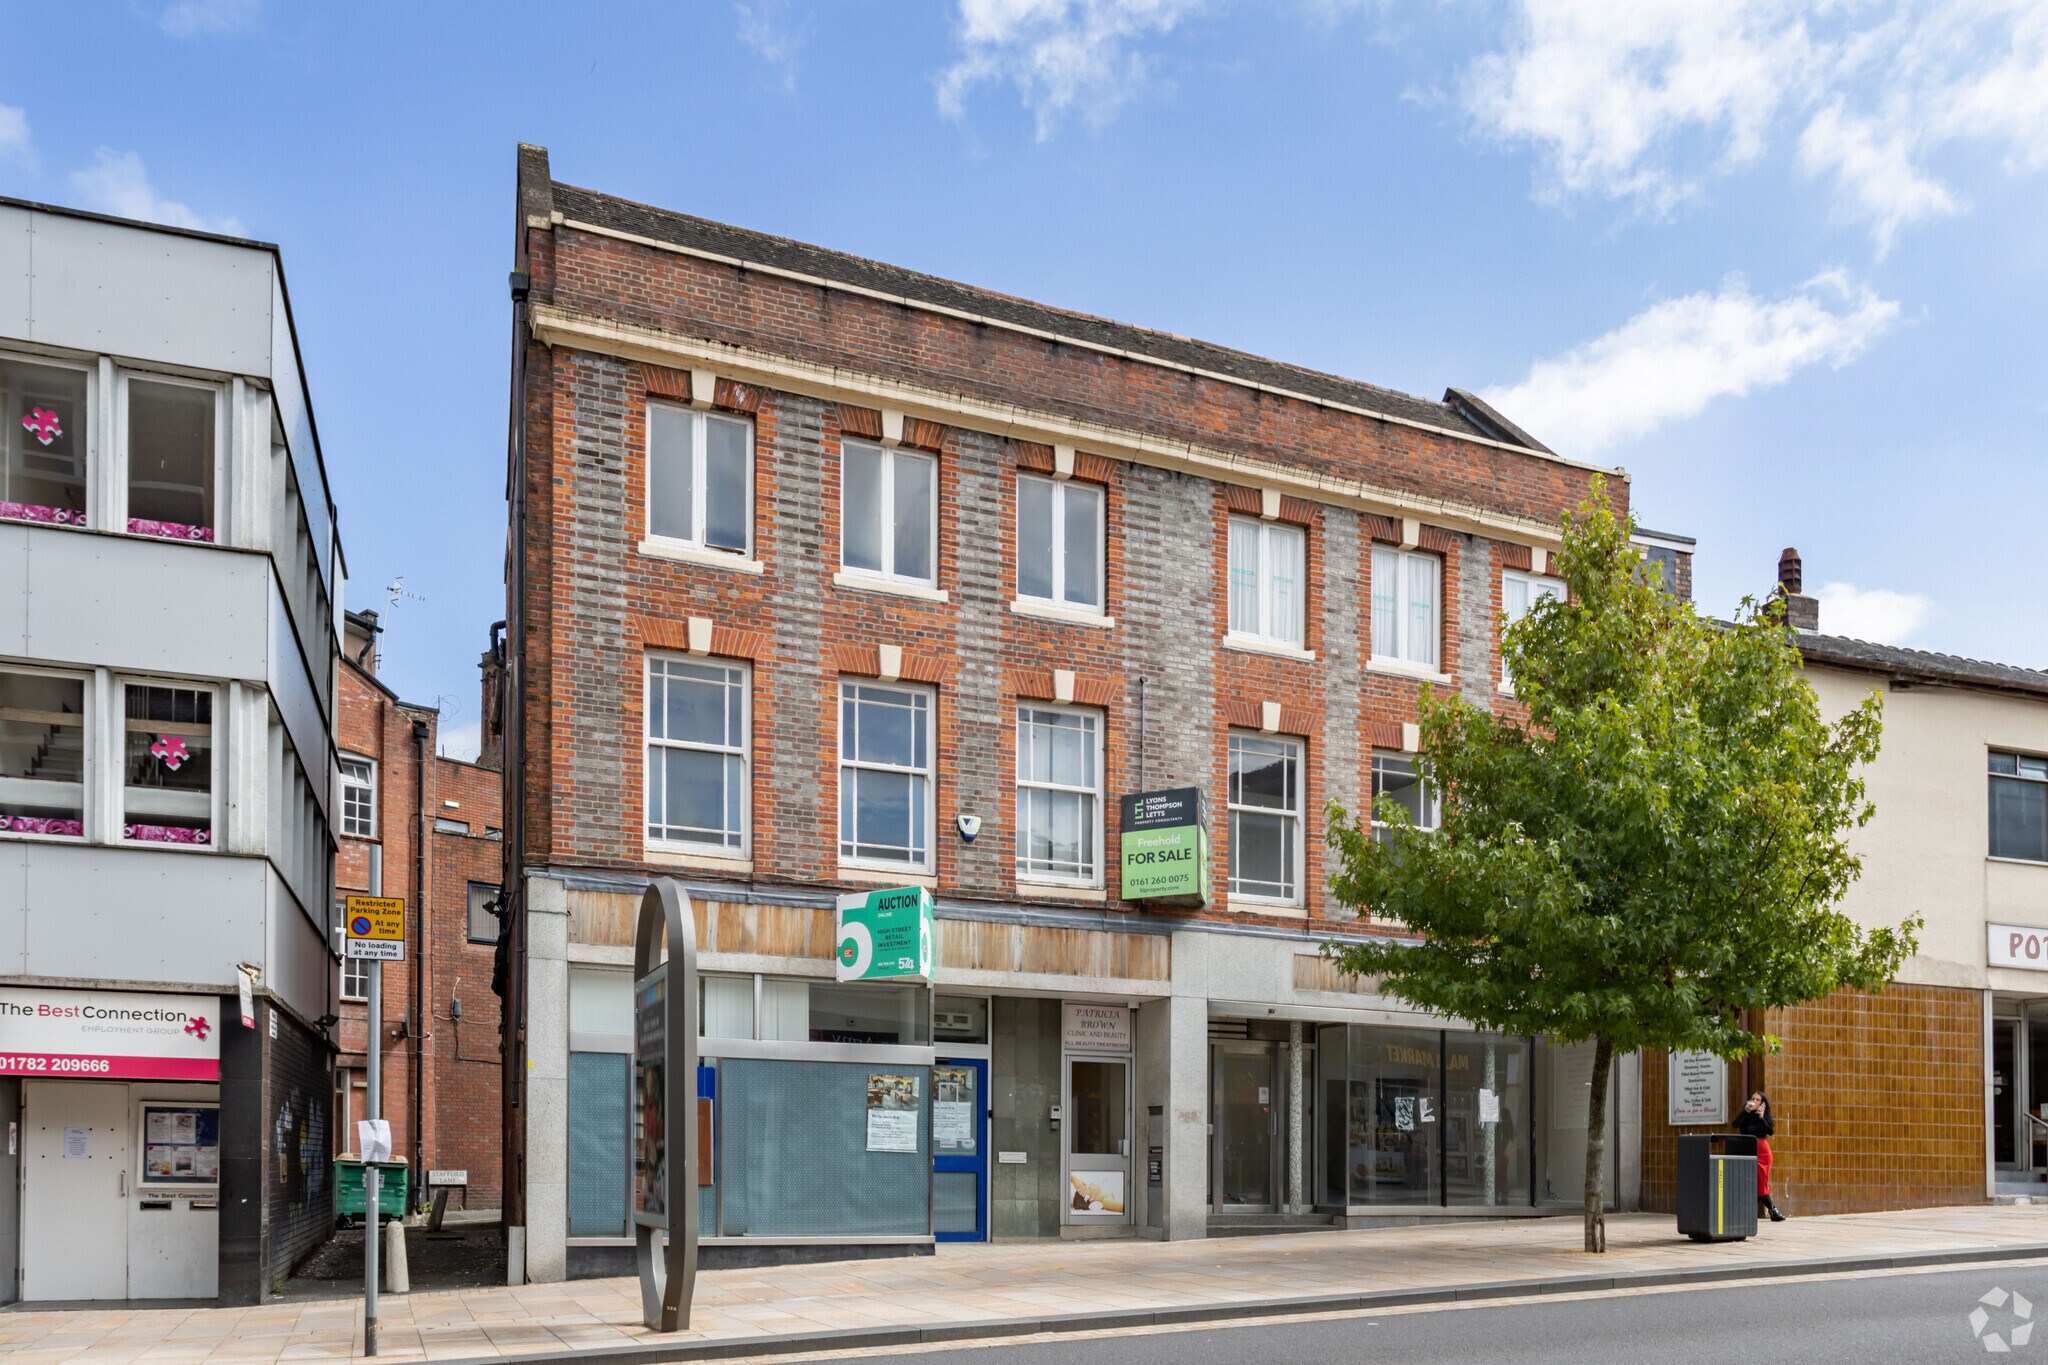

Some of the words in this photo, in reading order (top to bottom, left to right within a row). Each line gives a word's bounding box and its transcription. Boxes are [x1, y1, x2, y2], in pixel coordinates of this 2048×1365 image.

[1146, 796, 1166, 804] LYONS
[1146, 802, 1182, 810] THOMPSON
[1137, 834, 1180, 848] Freehold
[1128, 852, 1156, 866] FOR
[1158, 848, 1192, 862] SALE
[1130, 878, 1148, 886] 0161
[1152, 876, 1166, 884] 260
[1168, 874, 1189, 882] 0075
[878, 894, 918, 910] AUCTION
[350, 907, 380, 915] Parking
[369, 942, 396, 950] loading
[878, 940, 911, 948] INVESTMENT
[0, 1002, 34, 1016] The
[38, 1004, 79, 1017] Best
[82, 1006, 187, 1022] Connection
[1076, 1008, 1120, 1019] PATRICIA
[1080, 1020, 1116, 1030] BROWN
[81, 1026, 144, 1034] EMPLOYMENT
[146, 1027, 180, 1035] GROUP
[0, 1056, 46, 1070] 01782
[51, 1058, 110, 1072] 209666
